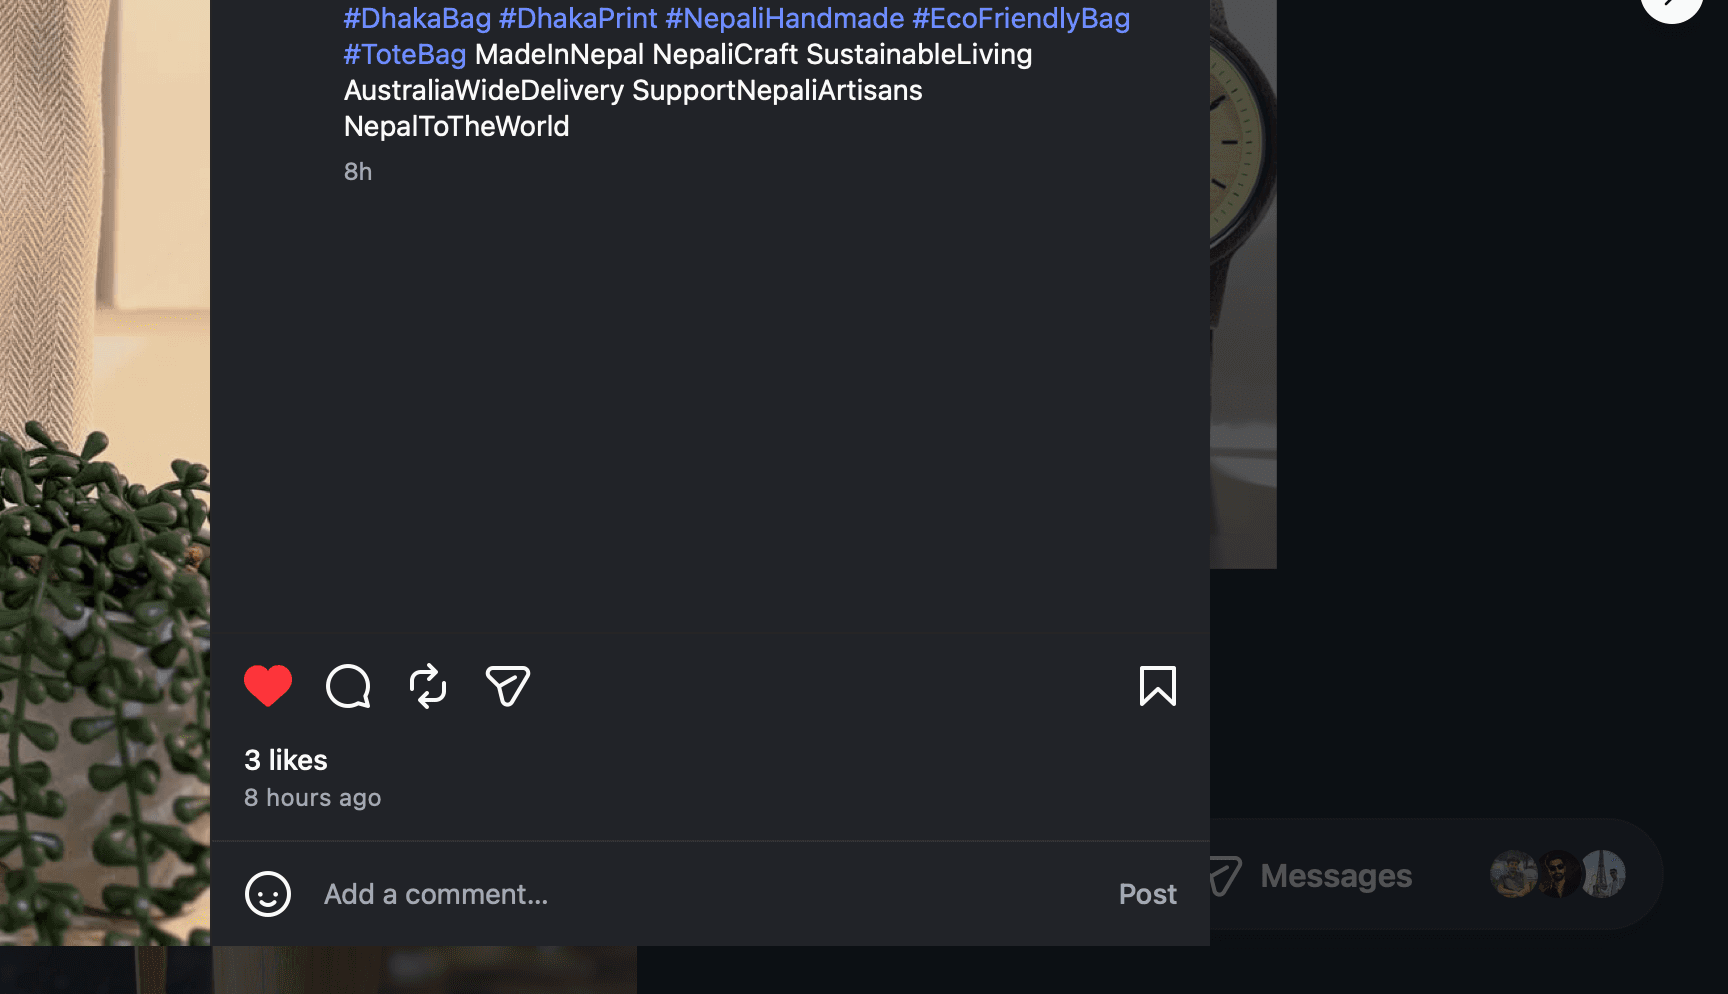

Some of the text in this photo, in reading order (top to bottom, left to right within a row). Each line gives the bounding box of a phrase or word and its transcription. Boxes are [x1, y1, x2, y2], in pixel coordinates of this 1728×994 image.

[343, 6, 1130, 34] #DhakaBag #DhakaPrint #NepaliHandmade #EcoFriendlyBag
[343, 41, 1032, 70] #ToteBag MadeInNepal NepaliCraft SustainableLiving
[343, 77, 923, 106] AustraliaWideDelivery SupportNepaliArtisans
[344, 114, 569, 142] NepalToTheWorld
[344, 161, 372, 181] 8h
[244, 747, 328, 772] 3 likes
[244, 787, 382, 811] 8 hours ago
[1261, 863, 1413, 894] Messages
[323, 882, 548, 905] Add a comment...
[1120, 882, 1178, 905] Post
